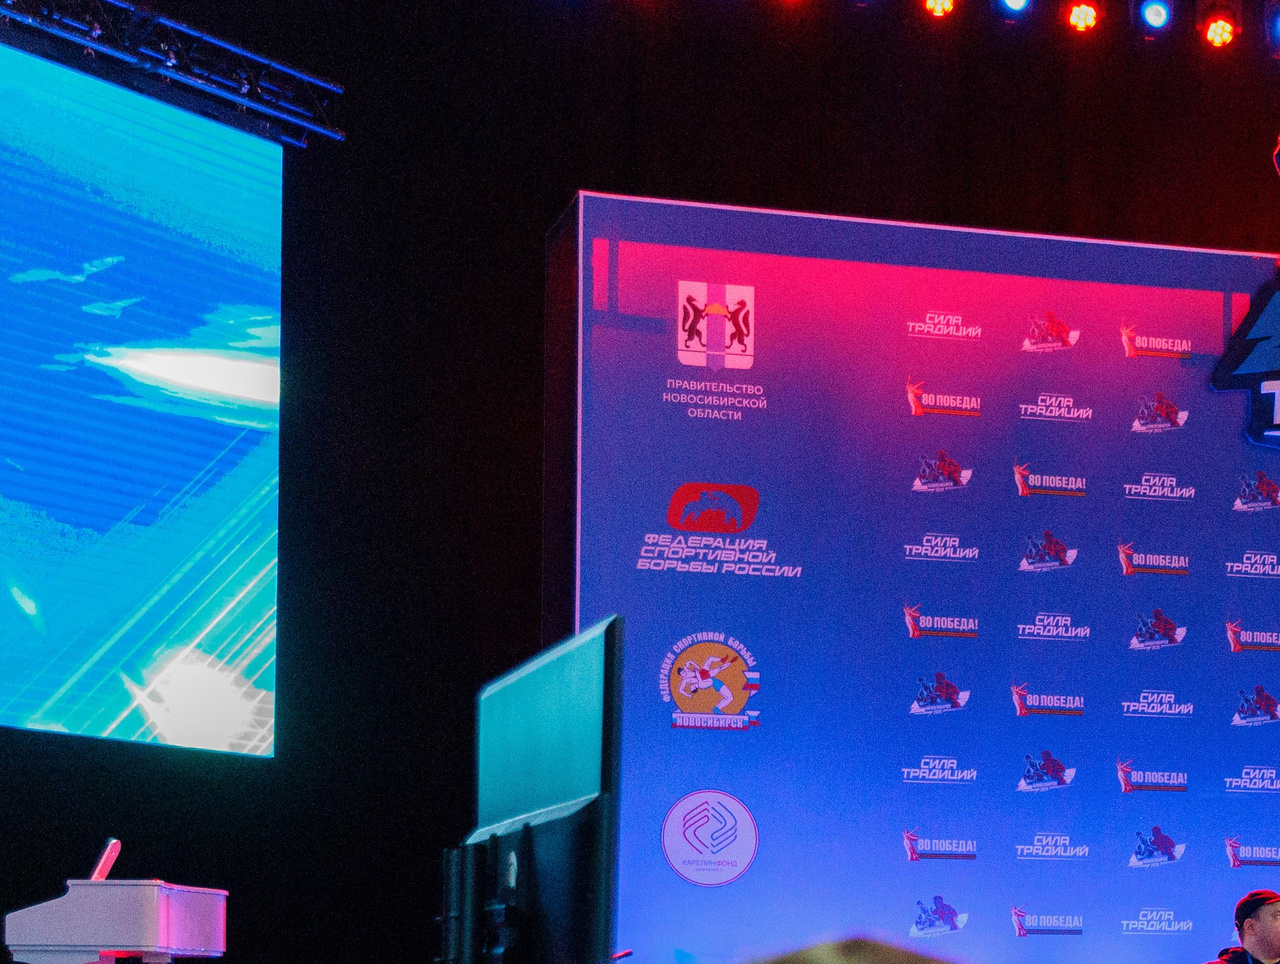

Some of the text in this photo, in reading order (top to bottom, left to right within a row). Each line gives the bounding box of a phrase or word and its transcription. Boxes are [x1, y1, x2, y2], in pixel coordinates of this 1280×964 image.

[926, 313, 962, 326] СИЛА
[907, 323, 981, 338] ТРАДИЦИЙ
[1135, 336, 1191, 351] 80 ПОБЕДА!
[667, 379, 763, 395] ПРАВИТЕЛЬСТВО
[662, 393, 767, 408] НОВОСИБИРСКОЙ
[922, 394, 980, 409] 80 ПОБЕДА!
[1037, 396, 1073, 407] СИЛА
[688, 408, 742, 420] ОБЛАСТИ
[1020, 404, 1092, 419] ТРАДИЦИЙ
[1028, 475, 1086, 489] 80 ПОБЕДА!
[1142, 475, 1176, 487] СИЛА
[1124, 484, 1195, 498] ТРАДИЦИЙ
[644, 533, 768, 550] ФЕДЕРАЦИЯ
[923, 536, 959, 547] СИЛА
[640, 546, 777, 564] СПОРТИВНОЙ
[904, 545, 979, 558] ТРАДИЦИЙ
[1133, 554, 1189, 567] 80 ПОБЕДА!
[1243, 554, 1276, 564] СИЛА
[636, 559, 802, 578] БОРЬБЫ РОССИИ
[919, 616, 978, 630] 80 ПОБЕДА!
[1035, 616, 1071, 626] СИЛА
[1017, 624, 1090, 637] ТРАДИЦИЙ
[1240, 631, 1252, 642] 80
[659, 631, 757, 703] ФЕДЕРАЦИЯ СПОРТИВНОЙ БОРЬБЫ
[1026, 695, 1084, 708] 80 ПОБЕДА!
[1140, 693, 1174, 703] СИЛА
[1122, 702, 1193, 714] ТРАДИЦИЙ
[676, 716, 744, 728] НОВОСИБИРСК
[920, 759, 957, 769] СИЛА
[902, 768, 977, 780] ТРАДИЦИЙ
[1131, 771, 1187, 784] 80 ПОБЕДА!
[1242, 769, 1276, 778] СИЛА
[918, 840, 976, 852] 80 ПОБЕДА!
[1034, 836, 1069, 845] СИЛА
[1016, 845, 1089, 857] ТРАДИЦИЙ
[1239, 847, 1251, 858] 80
[1025, 915, 1082, 927] 80 ПОБЕДА!
[1139, 911, 1173, 920] СИЛА
[1121, 920, 1193, 931] ТРАДИЦИЙ
